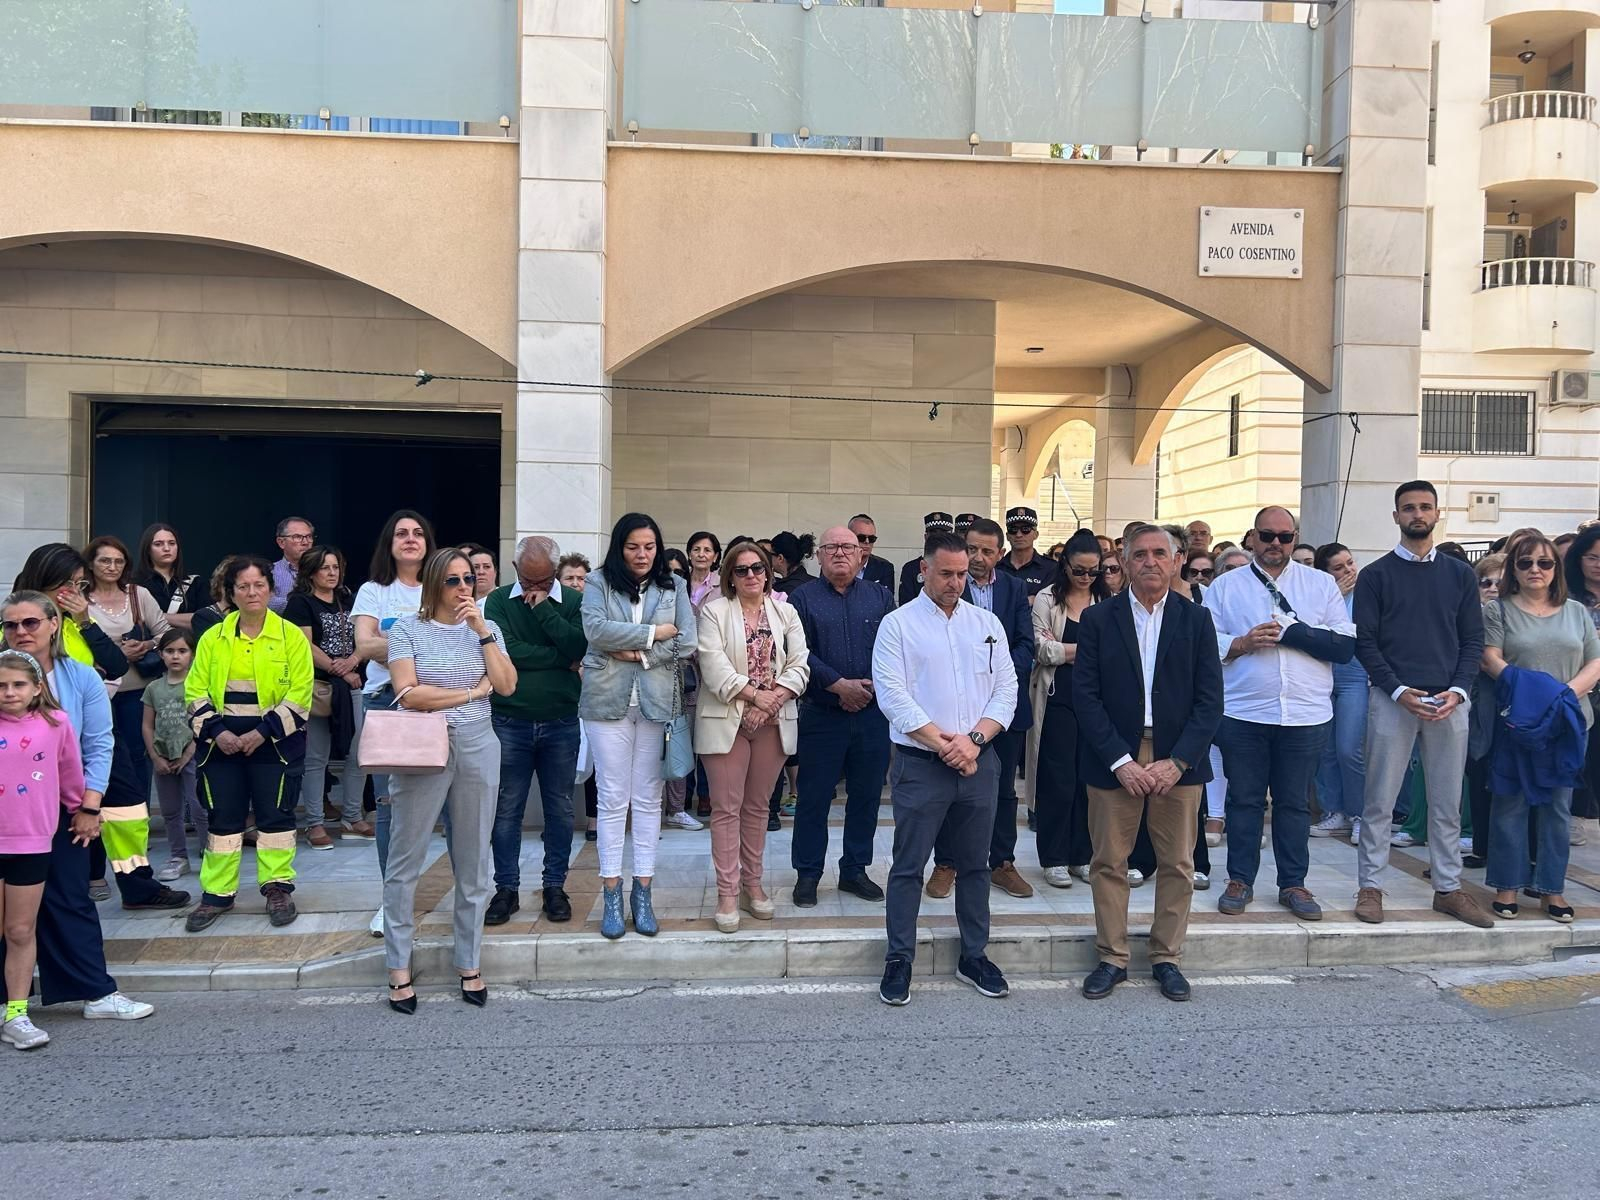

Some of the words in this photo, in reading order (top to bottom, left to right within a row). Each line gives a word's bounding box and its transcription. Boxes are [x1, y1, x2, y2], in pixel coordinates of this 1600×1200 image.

[1230, 223, 1274, 236] AVENIDA
[1208, 246, 1234, 259] PACO
[1239, 247, 1295, 261] COSENTINO
